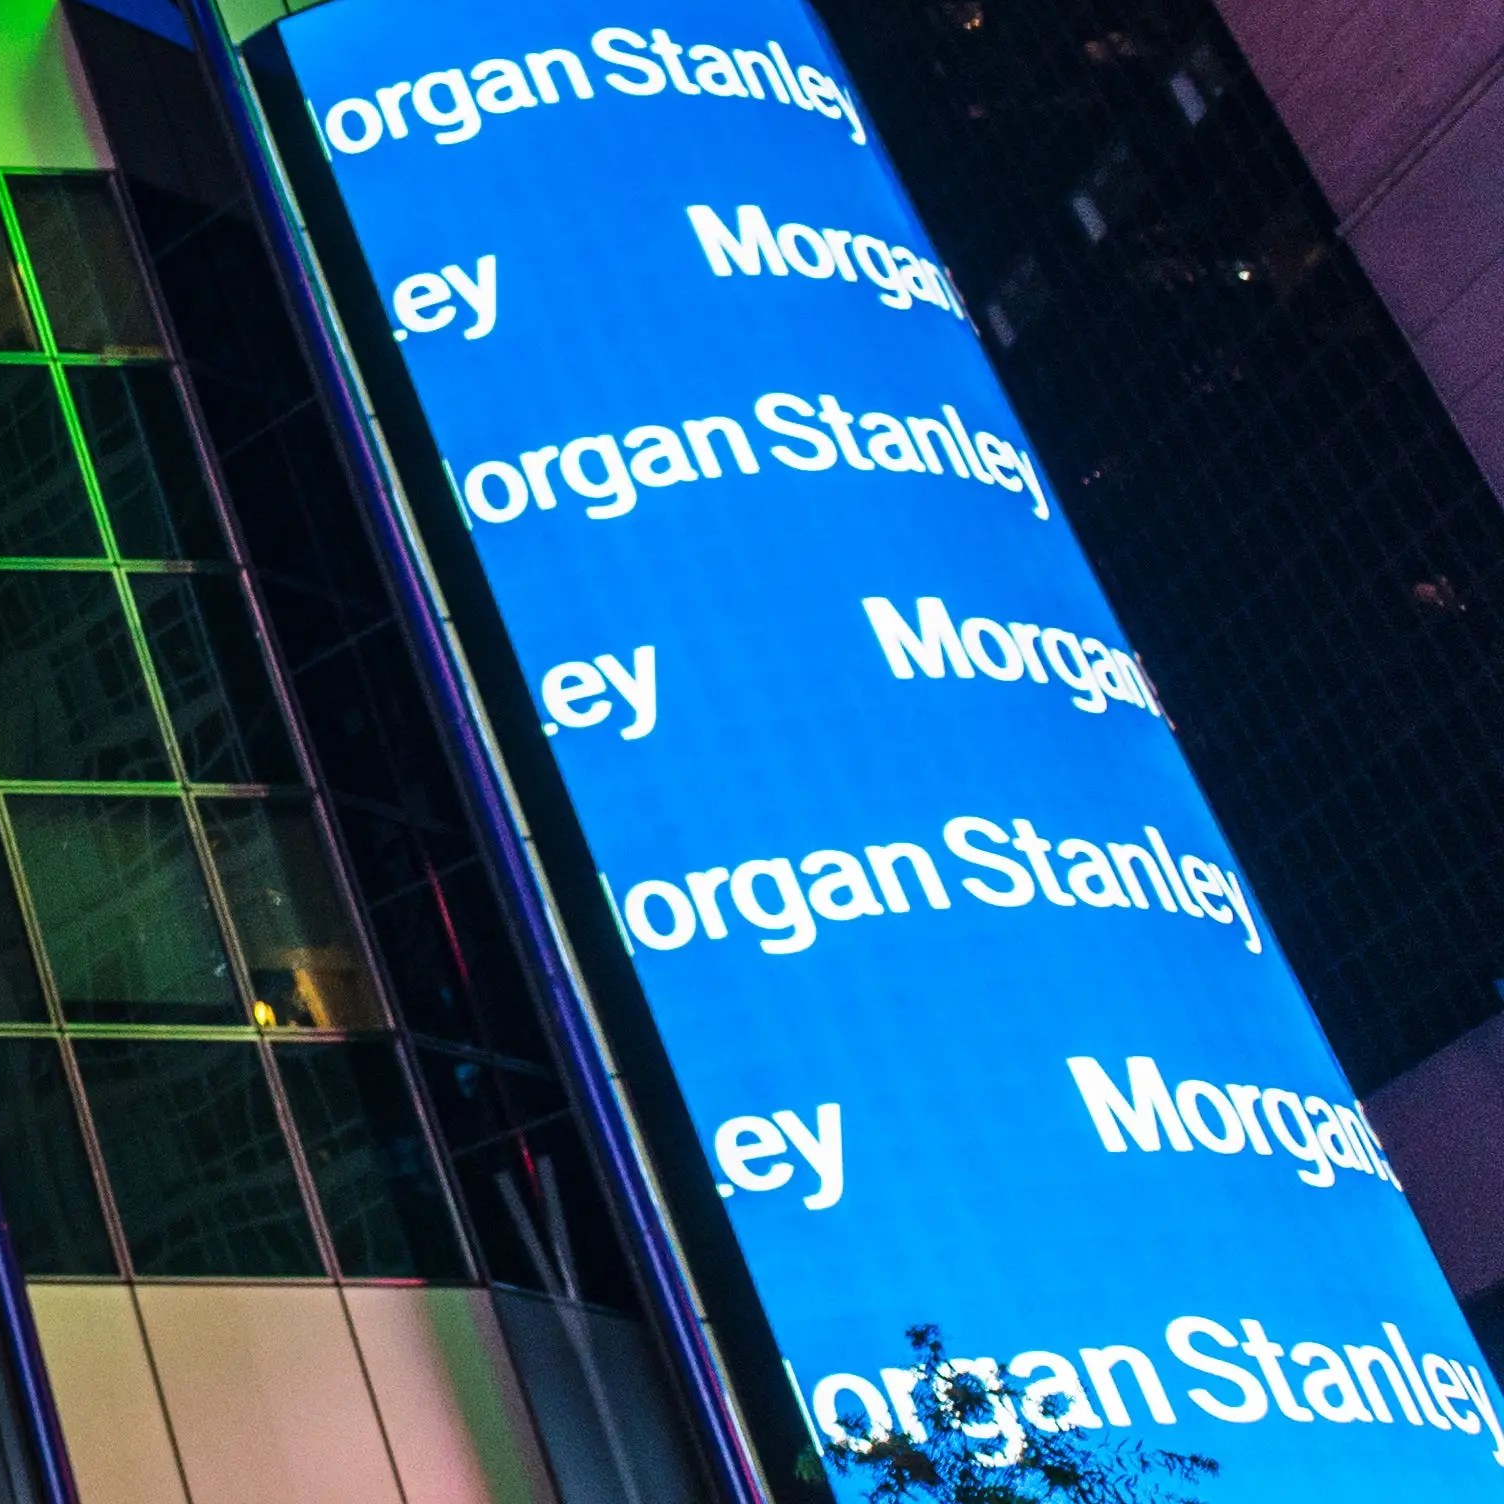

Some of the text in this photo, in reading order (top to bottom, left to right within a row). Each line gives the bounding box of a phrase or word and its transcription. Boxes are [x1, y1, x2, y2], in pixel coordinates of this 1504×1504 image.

[308, 28, 866, 159] organ Stanley
[394, 255, 496, 341] ey
[687, 205, 963, 318] Morgan
[445, 393, 1049, 527] organ Stanley
[542, 646, 656, 739] ey
[863, 597, 1160, 716] Morgan
[600, 817, 1261, 954] organ Stanley
[715, 1104, 843, 1210] ey
[1067, 1056, 1389, 1188] Morgan
[785, 1316, 1504, 1467] organ Stanley
